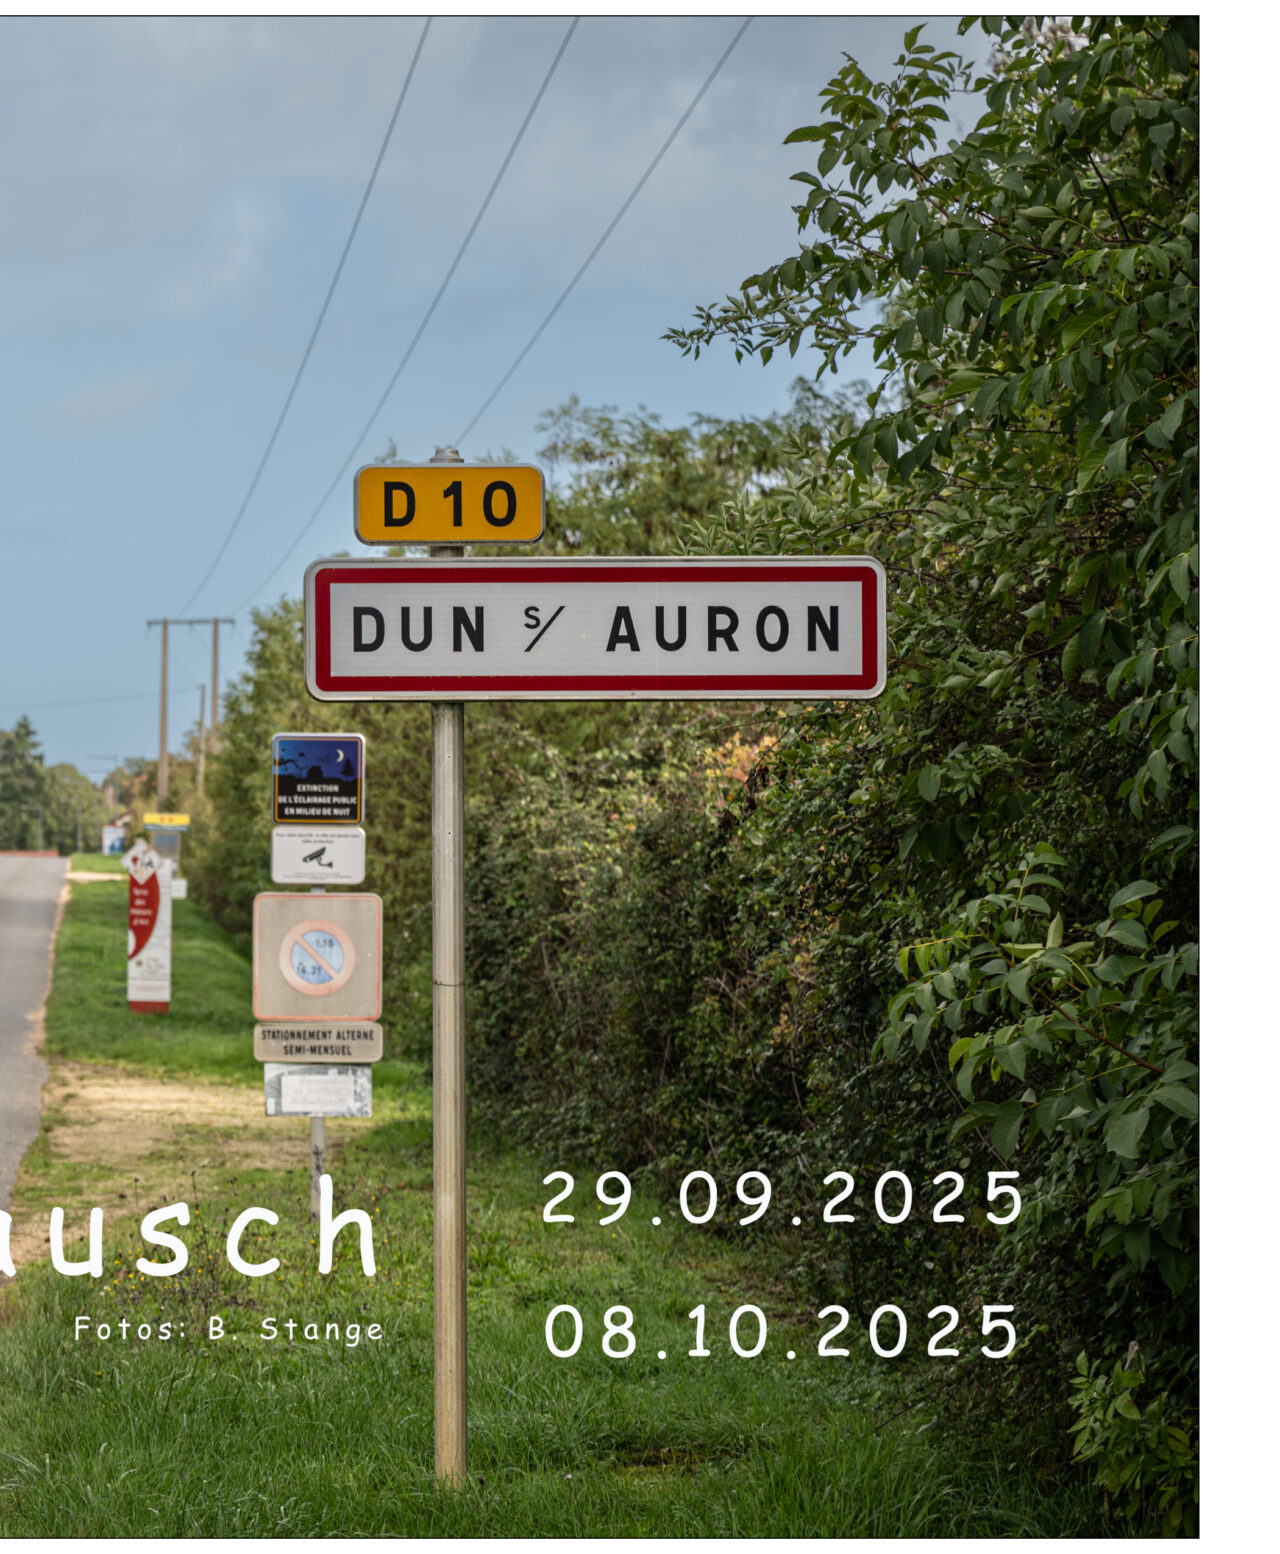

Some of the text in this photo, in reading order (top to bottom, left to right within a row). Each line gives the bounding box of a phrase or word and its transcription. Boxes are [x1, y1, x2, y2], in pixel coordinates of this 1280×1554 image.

[383, 479, 518, 528] D 10
[352, 605, 486, 653] DUN
[605, 604, 840, 653] AURON
[296, 783, 339, 792] EXTINCTION
[278, 795, 287, 804] DE
[332, 795, 358, 804] PUBLIC
[284, 807, 350, 816] EN MILIEU DE NUIT
[261, 1028, 375, 1040] STATIONNEMENT ALTERNÉ
[283, 1044, 352, 1056] SEMI-MENSUEL
